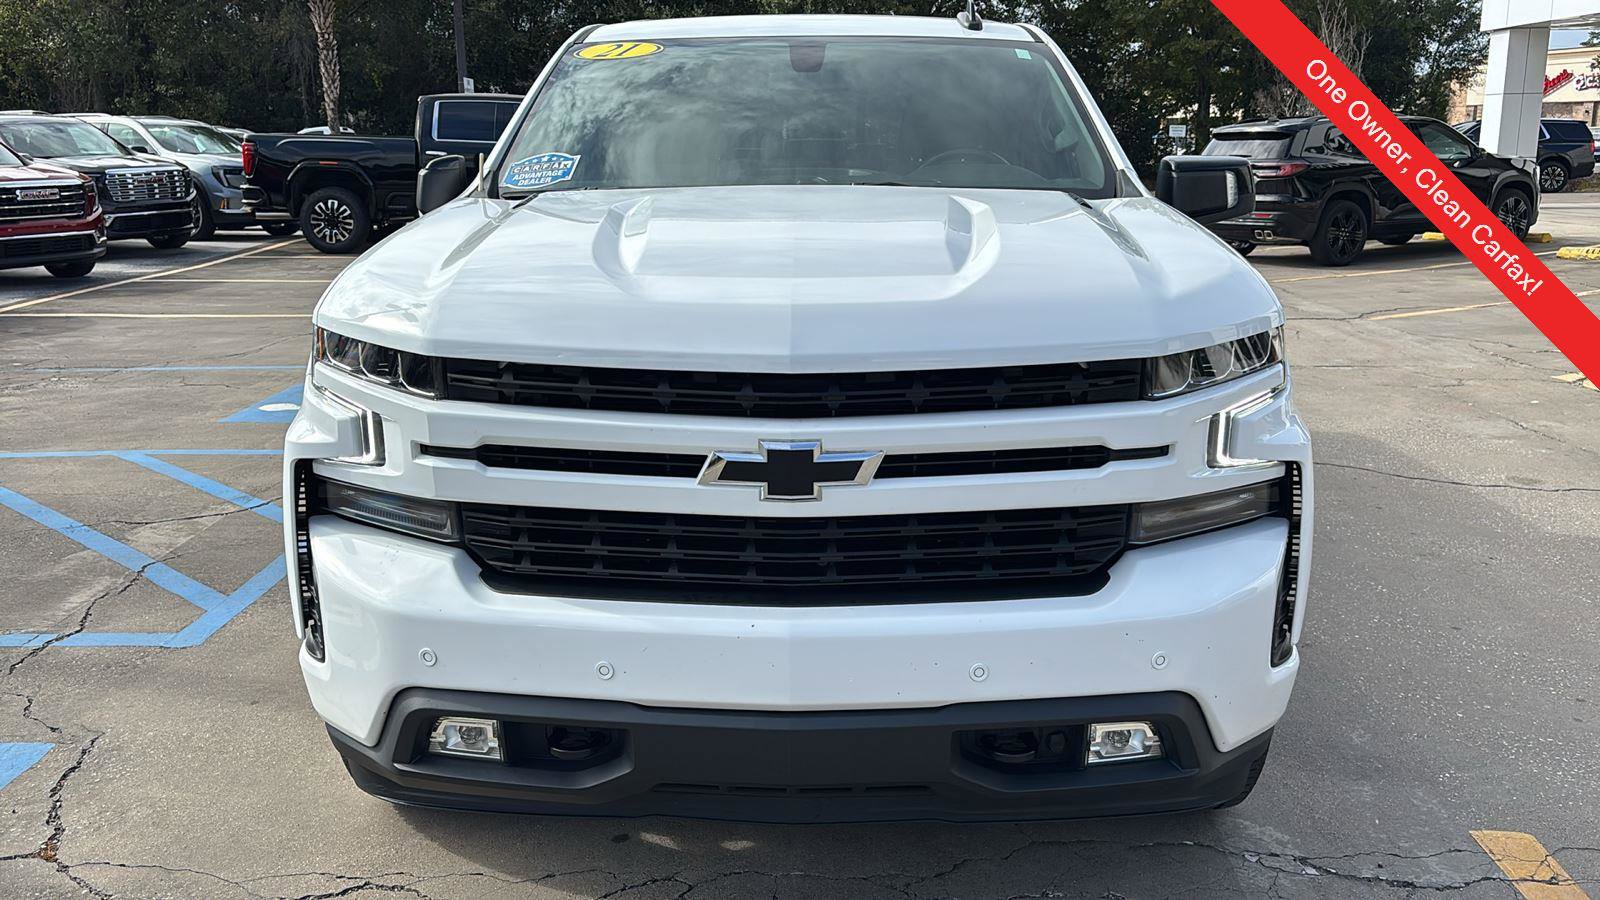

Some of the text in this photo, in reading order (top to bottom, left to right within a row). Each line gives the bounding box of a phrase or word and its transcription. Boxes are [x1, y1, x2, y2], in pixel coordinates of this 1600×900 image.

[592, 43, 642, 58] 21
[512, 161, 573, 173] CARFAX
[512, 169, 565, 180] ADVANTAGE
[517, 177, 552, 186] DEALER
